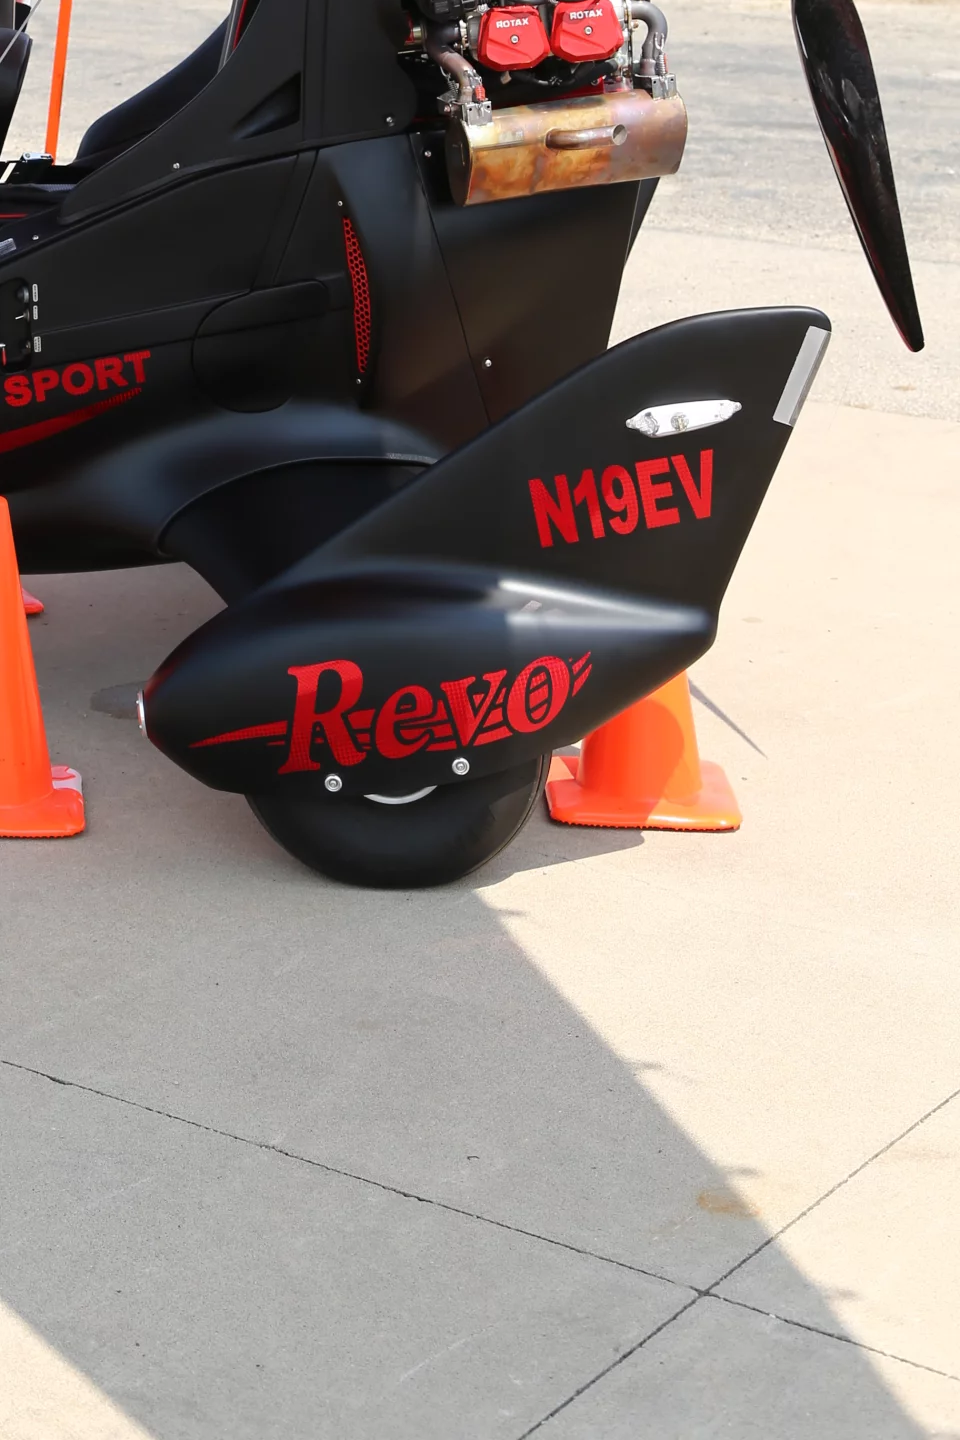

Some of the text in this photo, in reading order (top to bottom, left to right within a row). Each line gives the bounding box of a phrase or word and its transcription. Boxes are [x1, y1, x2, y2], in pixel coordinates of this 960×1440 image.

[496, 18, 529, 29] ROTAX
[569, 9, 603, 20] ROTAX
[3, 350, 151, 408] SPORT
[527, 448, 714, 548] N19EV
